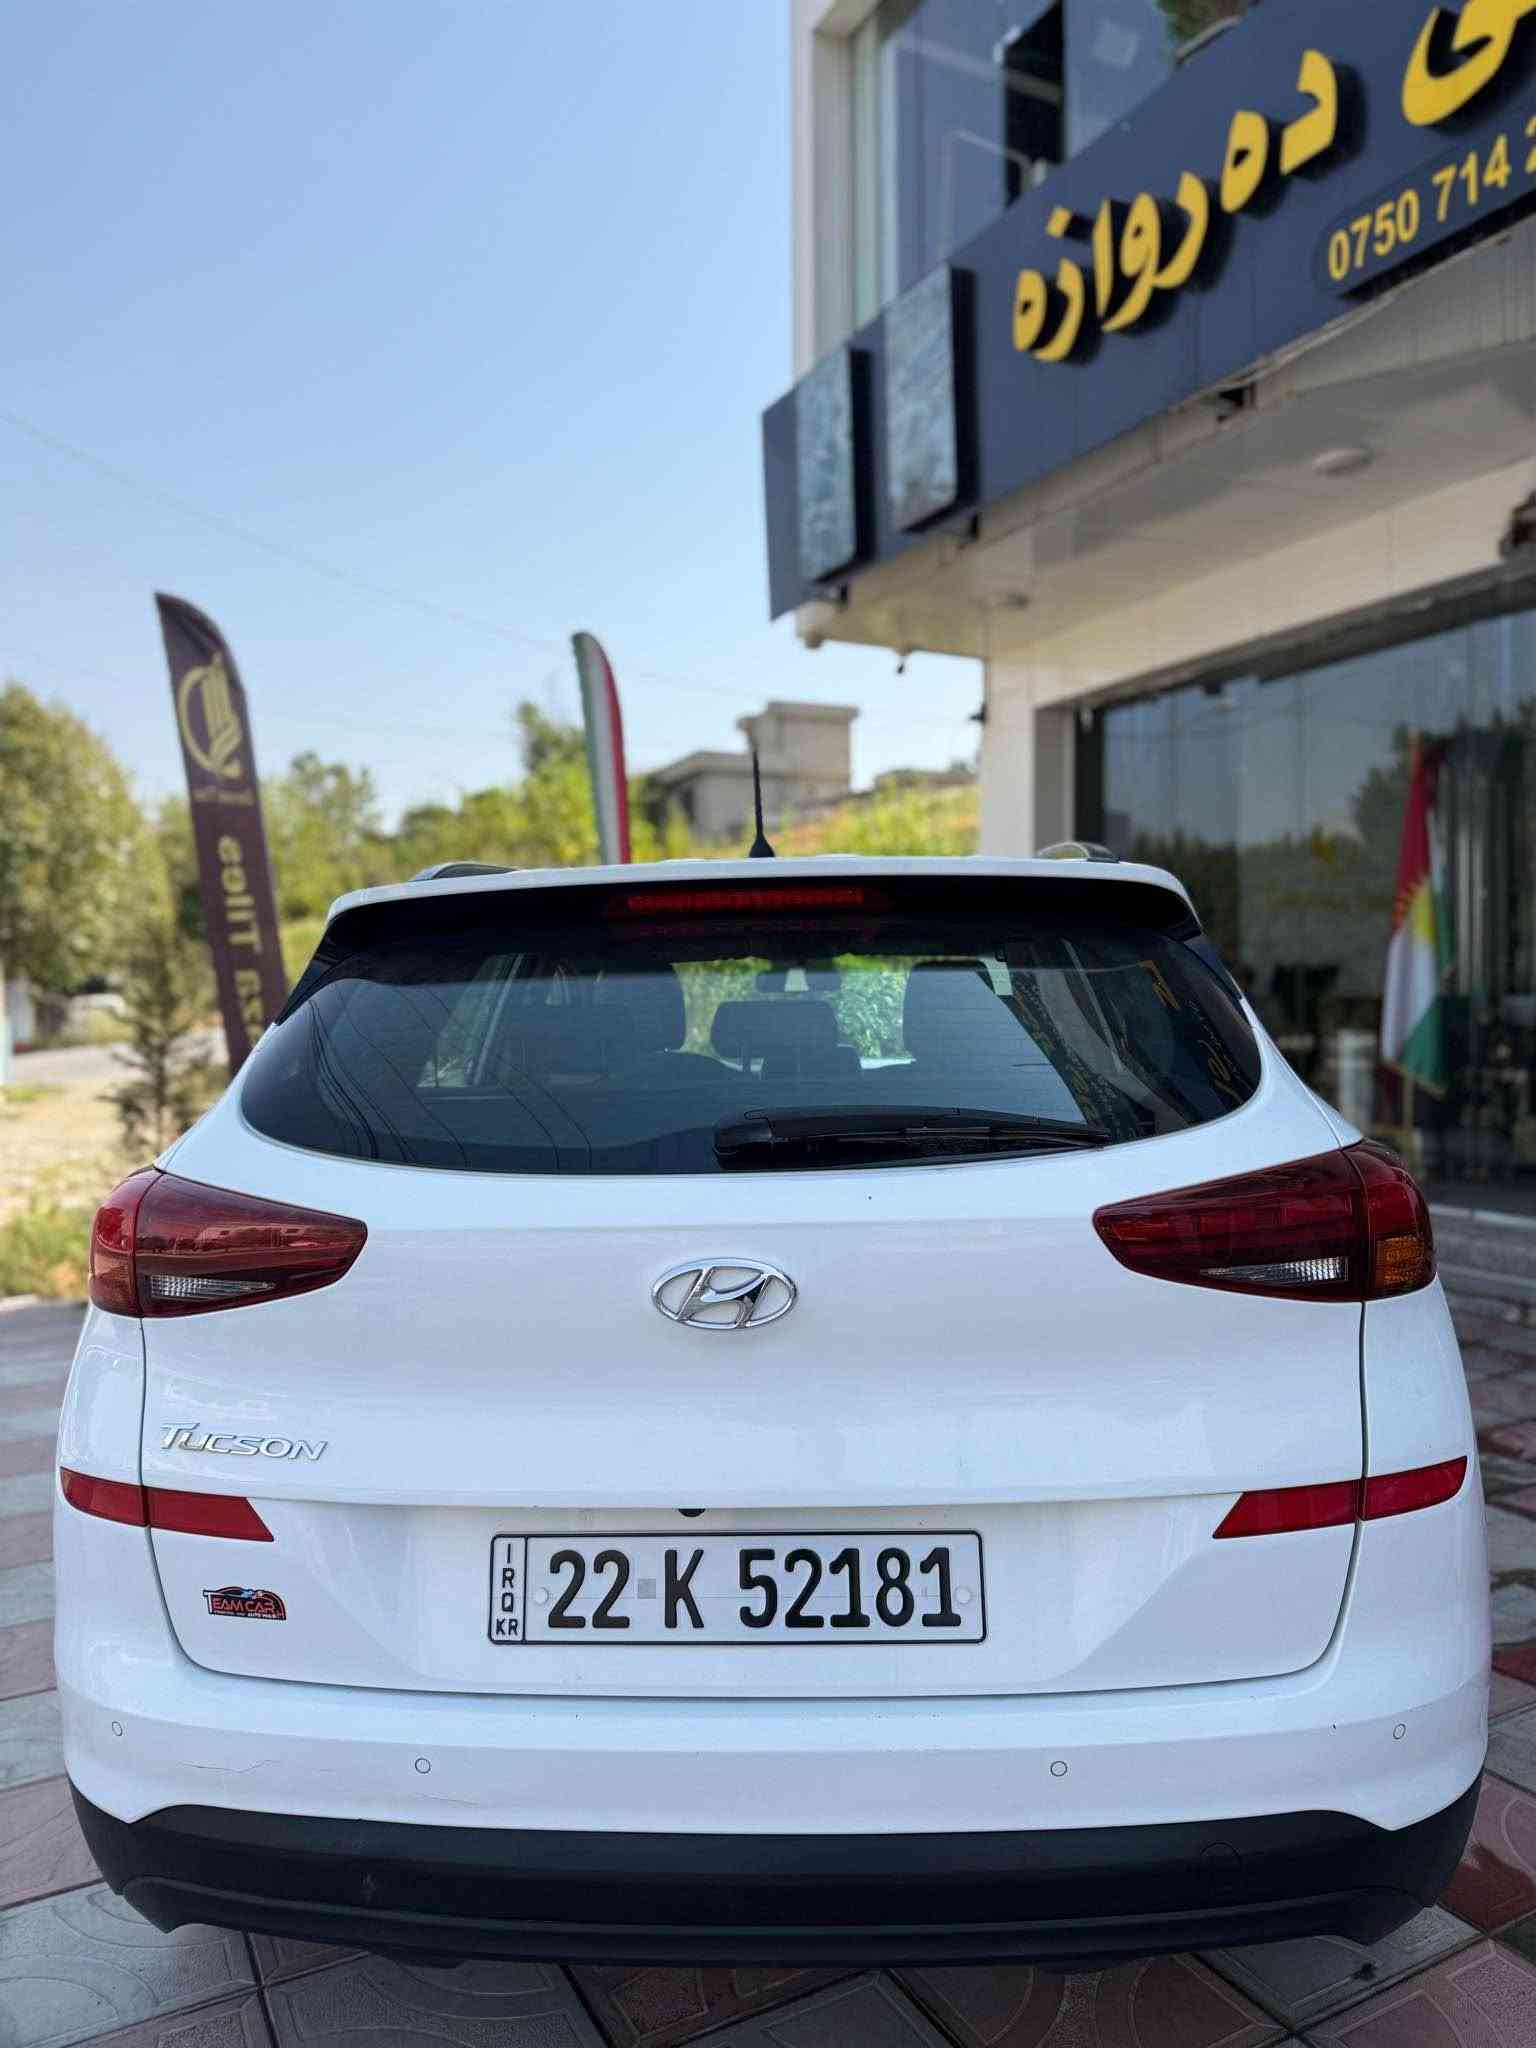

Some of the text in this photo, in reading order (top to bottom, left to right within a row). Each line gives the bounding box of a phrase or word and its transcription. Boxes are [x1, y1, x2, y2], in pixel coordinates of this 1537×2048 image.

[1328, 188, 1420, 280] 0750
[1432, 134, 1511, 222] 714
[160, 1422, 328, 1461] TUCSON
[547, 1546, 963, 1629] 22 K 52181
[245, 1600, 276, 1615] CAR
[495, 1618, 518, 1636] KR
